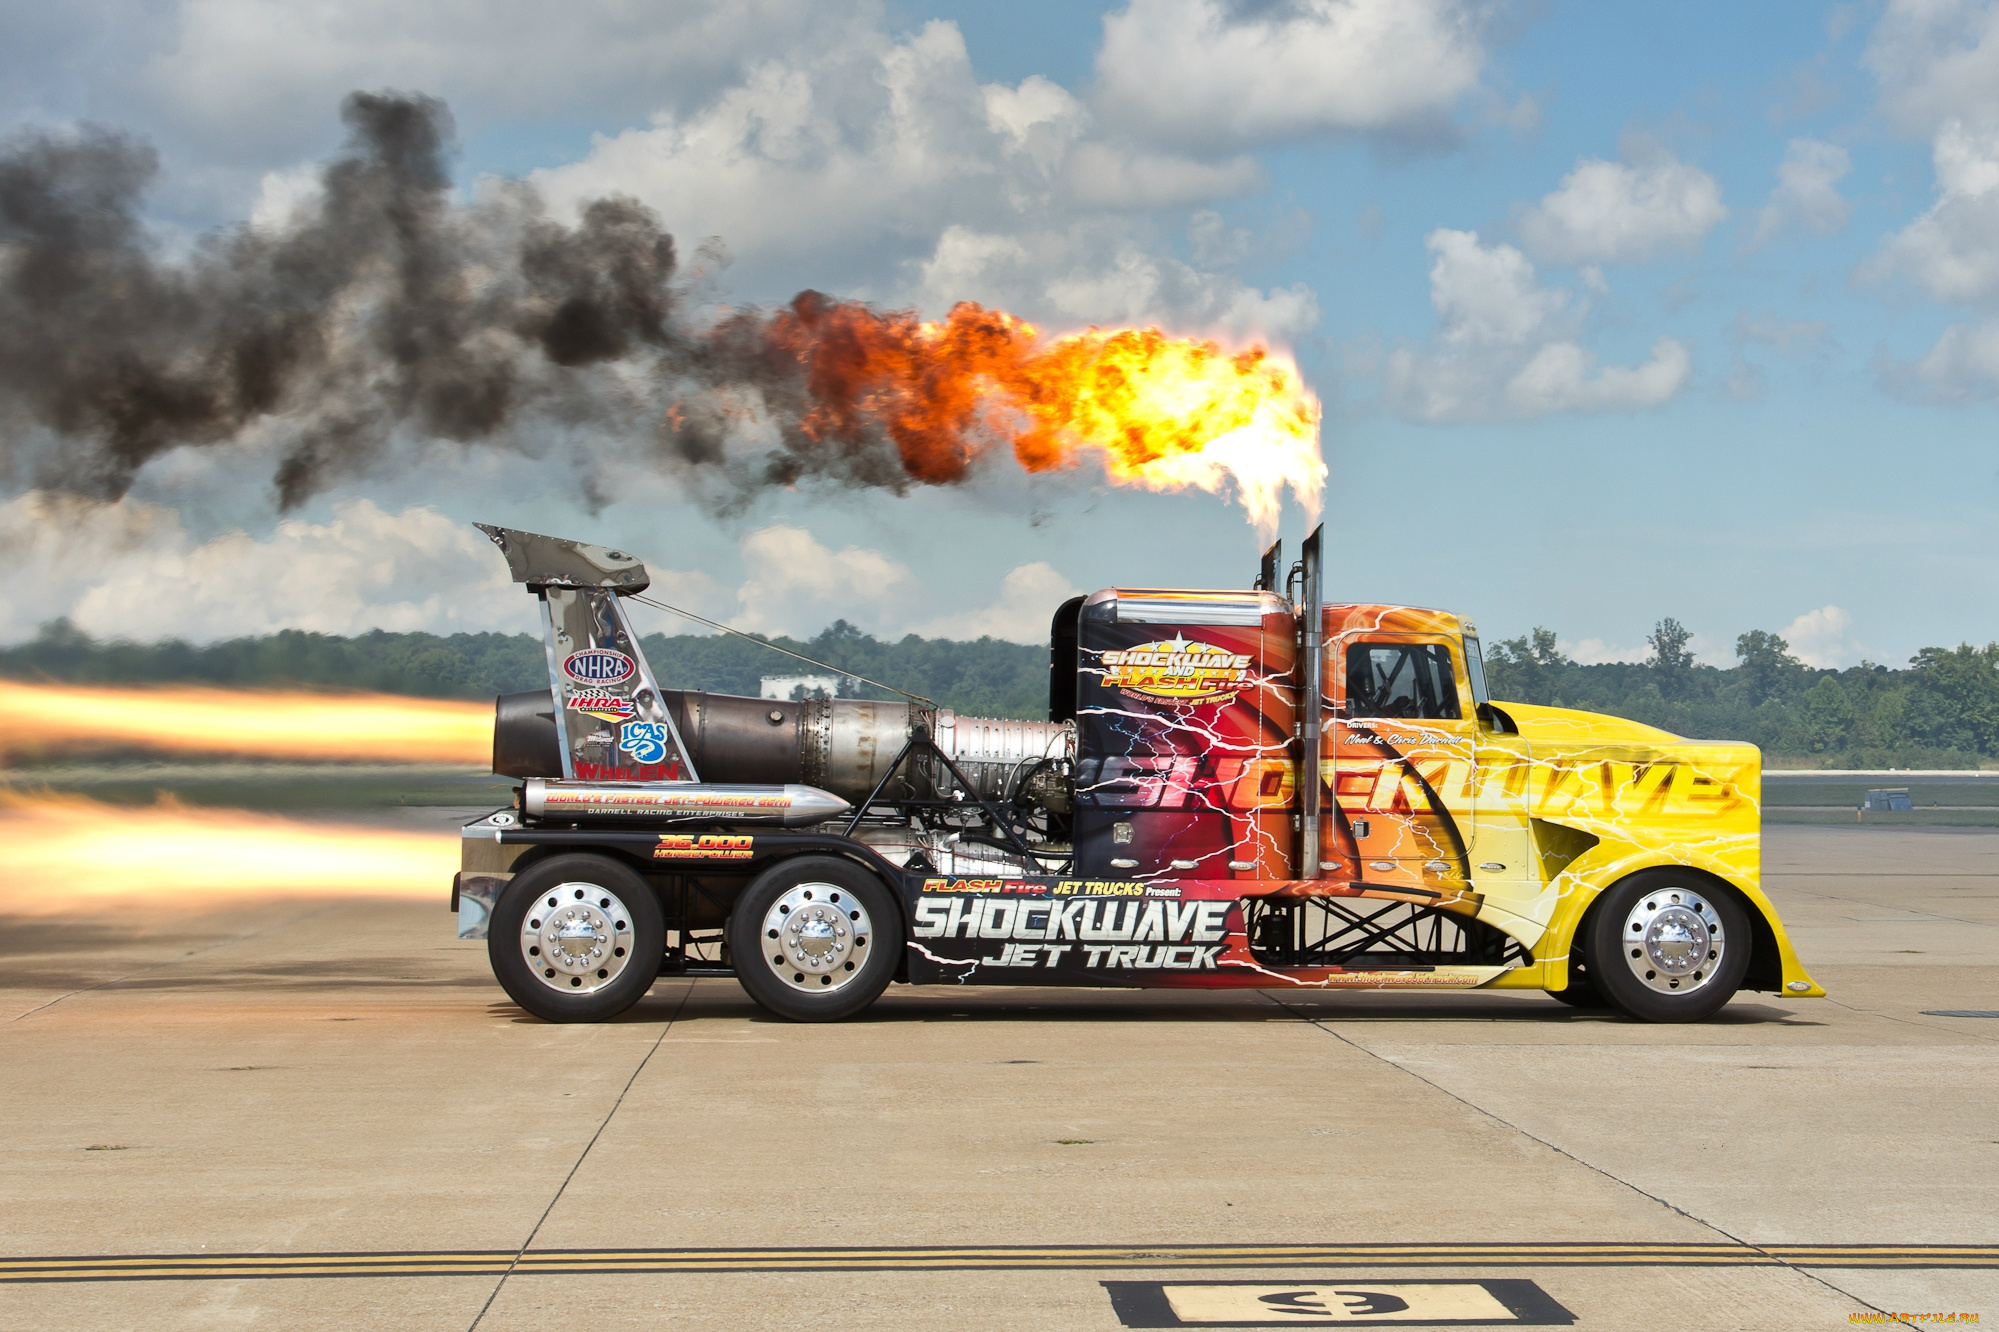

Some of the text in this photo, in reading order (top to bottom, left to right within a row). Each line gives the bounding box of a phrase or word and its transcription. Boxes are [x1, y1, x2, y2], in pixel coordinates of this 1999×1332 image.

[575, 649, 623, 658] CHAMPIONSHIP
[1101, 650, 1254, 669] SHOCKWAVE
[575, 656, 624, 678] NHRA
[1163, 666, 1195, 677] AND
[575, 675, 593, 684] DRAG
[1101, 674, 1254, 692] FLASH Fire
[571, 698, 622, 708] IHRA
[1120, 688, 1236, 706] WORLD'S FASTEST JET TRUCKS
[623, 723, 664, 742] ICAS
[1373, 734, 1383, 745] &
[1387, 733, 1417, 745] Chris
[574, 762, 678, 781] WHELEN
[546, 793, 792, 807] WORLD'S FASTEST JET-POWERED SEMI
[588, 808, 634, 816] DARNELL
[676, 809, 745, 817] ENTERPRISES
[655, 834, 754, 850] 36,000
[653, 849, 754, 859] HORSEPOWER
[922, 878, 1181, 897] FLASH Fire JET TRUCKS Present:
[913, 896, 1235, 941] SHOCKWAVE
[981, 943, 1229, 969] JET TRUCK
